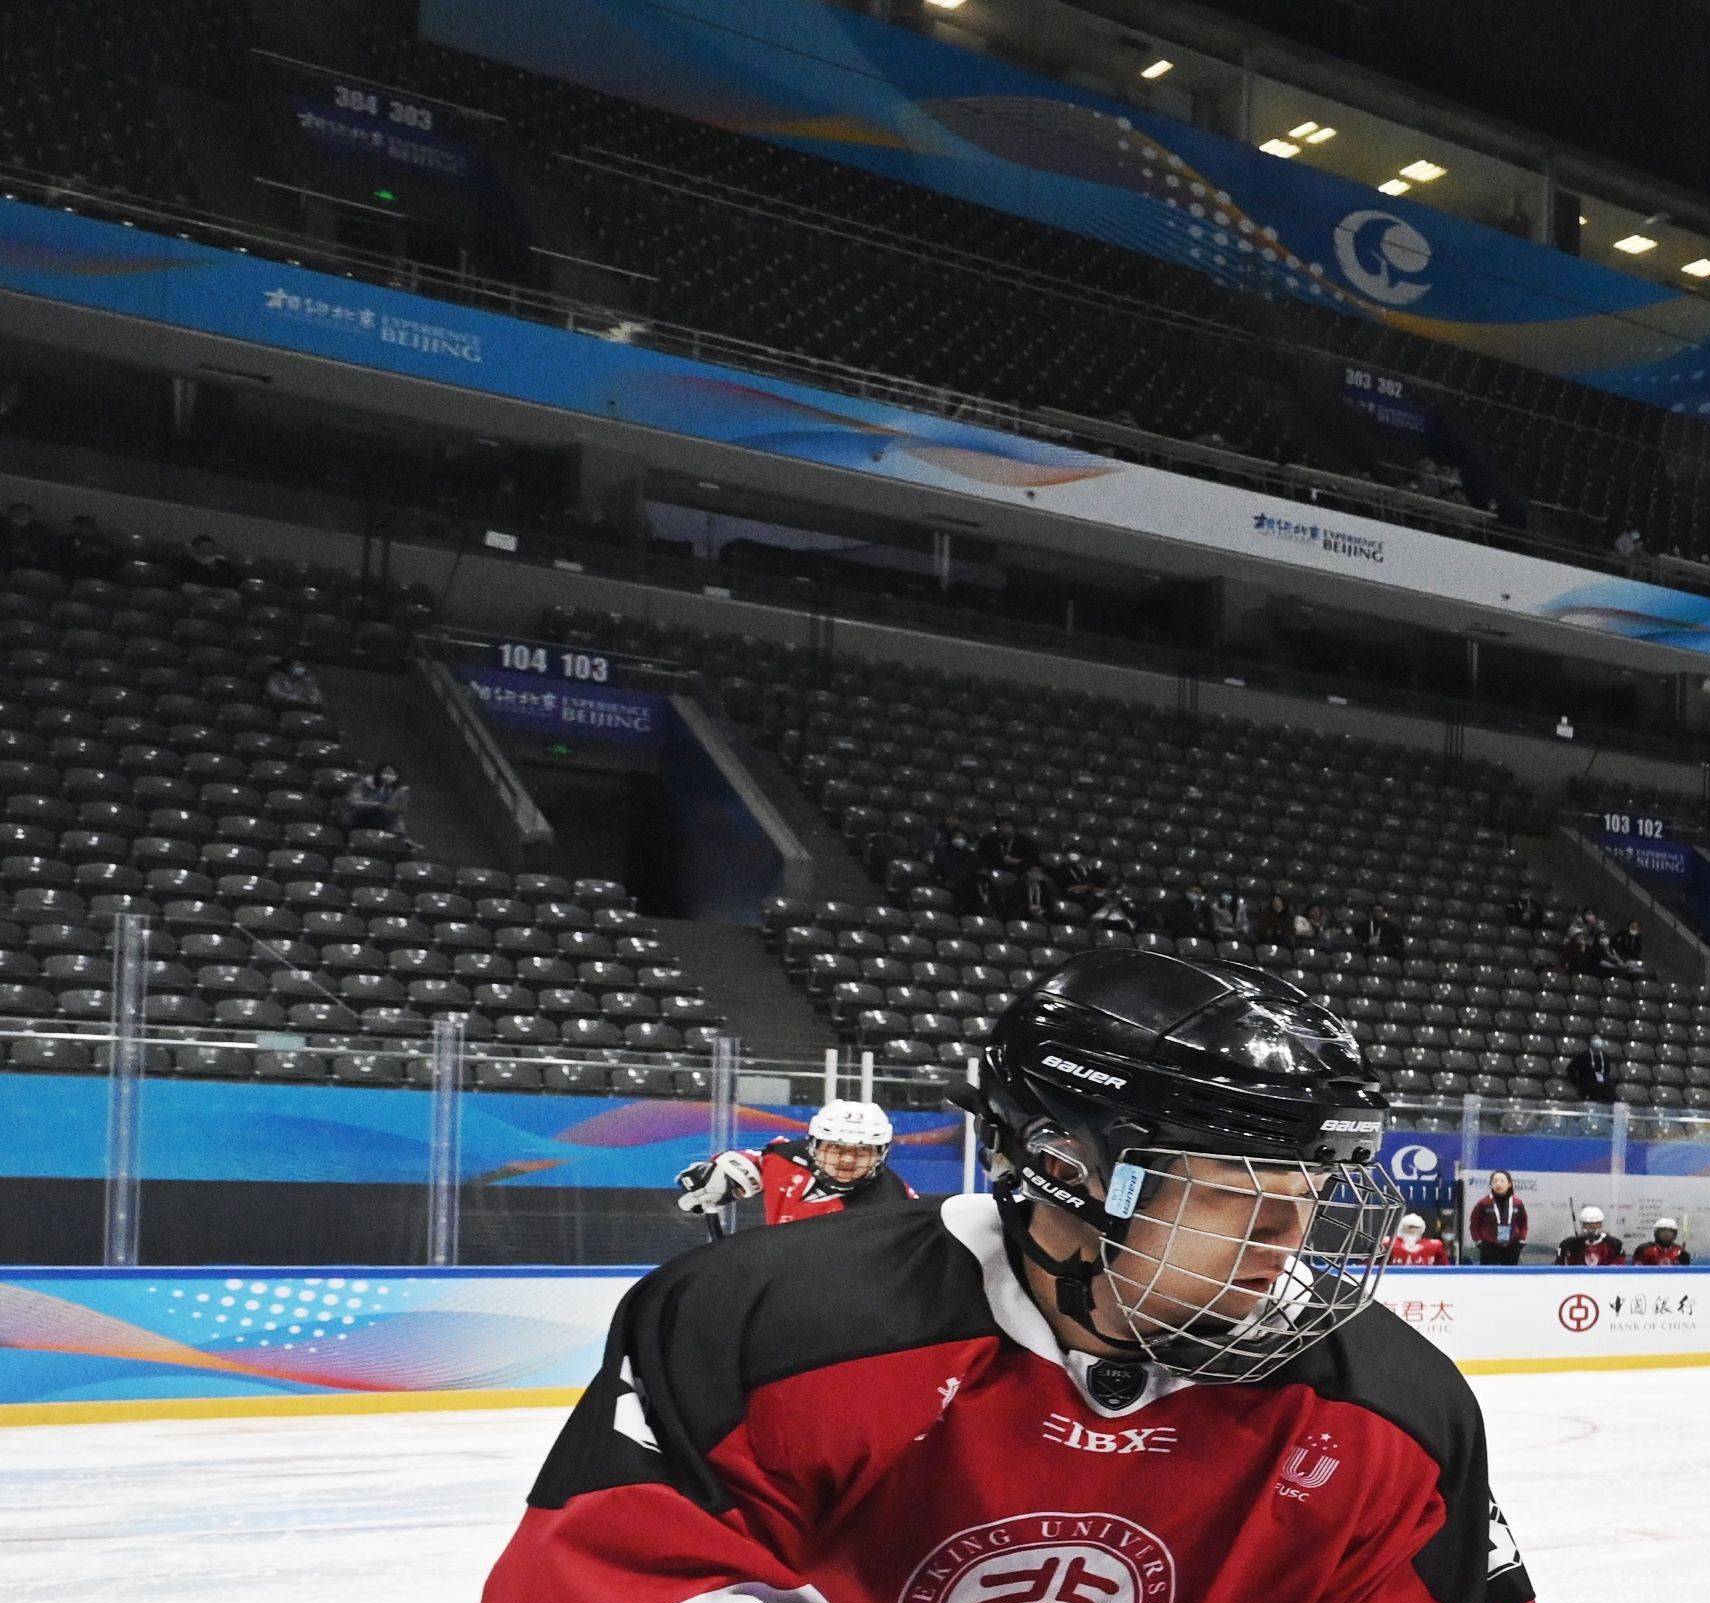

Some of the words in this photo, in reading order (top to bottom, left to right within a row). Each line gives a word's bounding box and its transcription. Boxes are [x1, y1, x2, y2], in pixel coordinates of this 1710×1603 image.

[1323, 538, 1384, 563] BEIJING
[500, 643, 547, 672] 104
[561, 653, 608, 682] 103
[562, 706, 651, 732] BEIJING
[1604, 813, 1631, 834] 103
[1638, 818, 1664, 839] 102
[1040, 1055, 1127, 1090] BAUER
[1320, 1119, 1381, 1133] BAUER
[1021, 1166, 1086, 1209] BAUER
[1609, 1323, 1640, 1332] BANK
[1643, 1323, 1658, 1332] OF
[1661, 1322, 1697, 1331] CHINA
[1062, 1420, 1156, 1455] IBX
